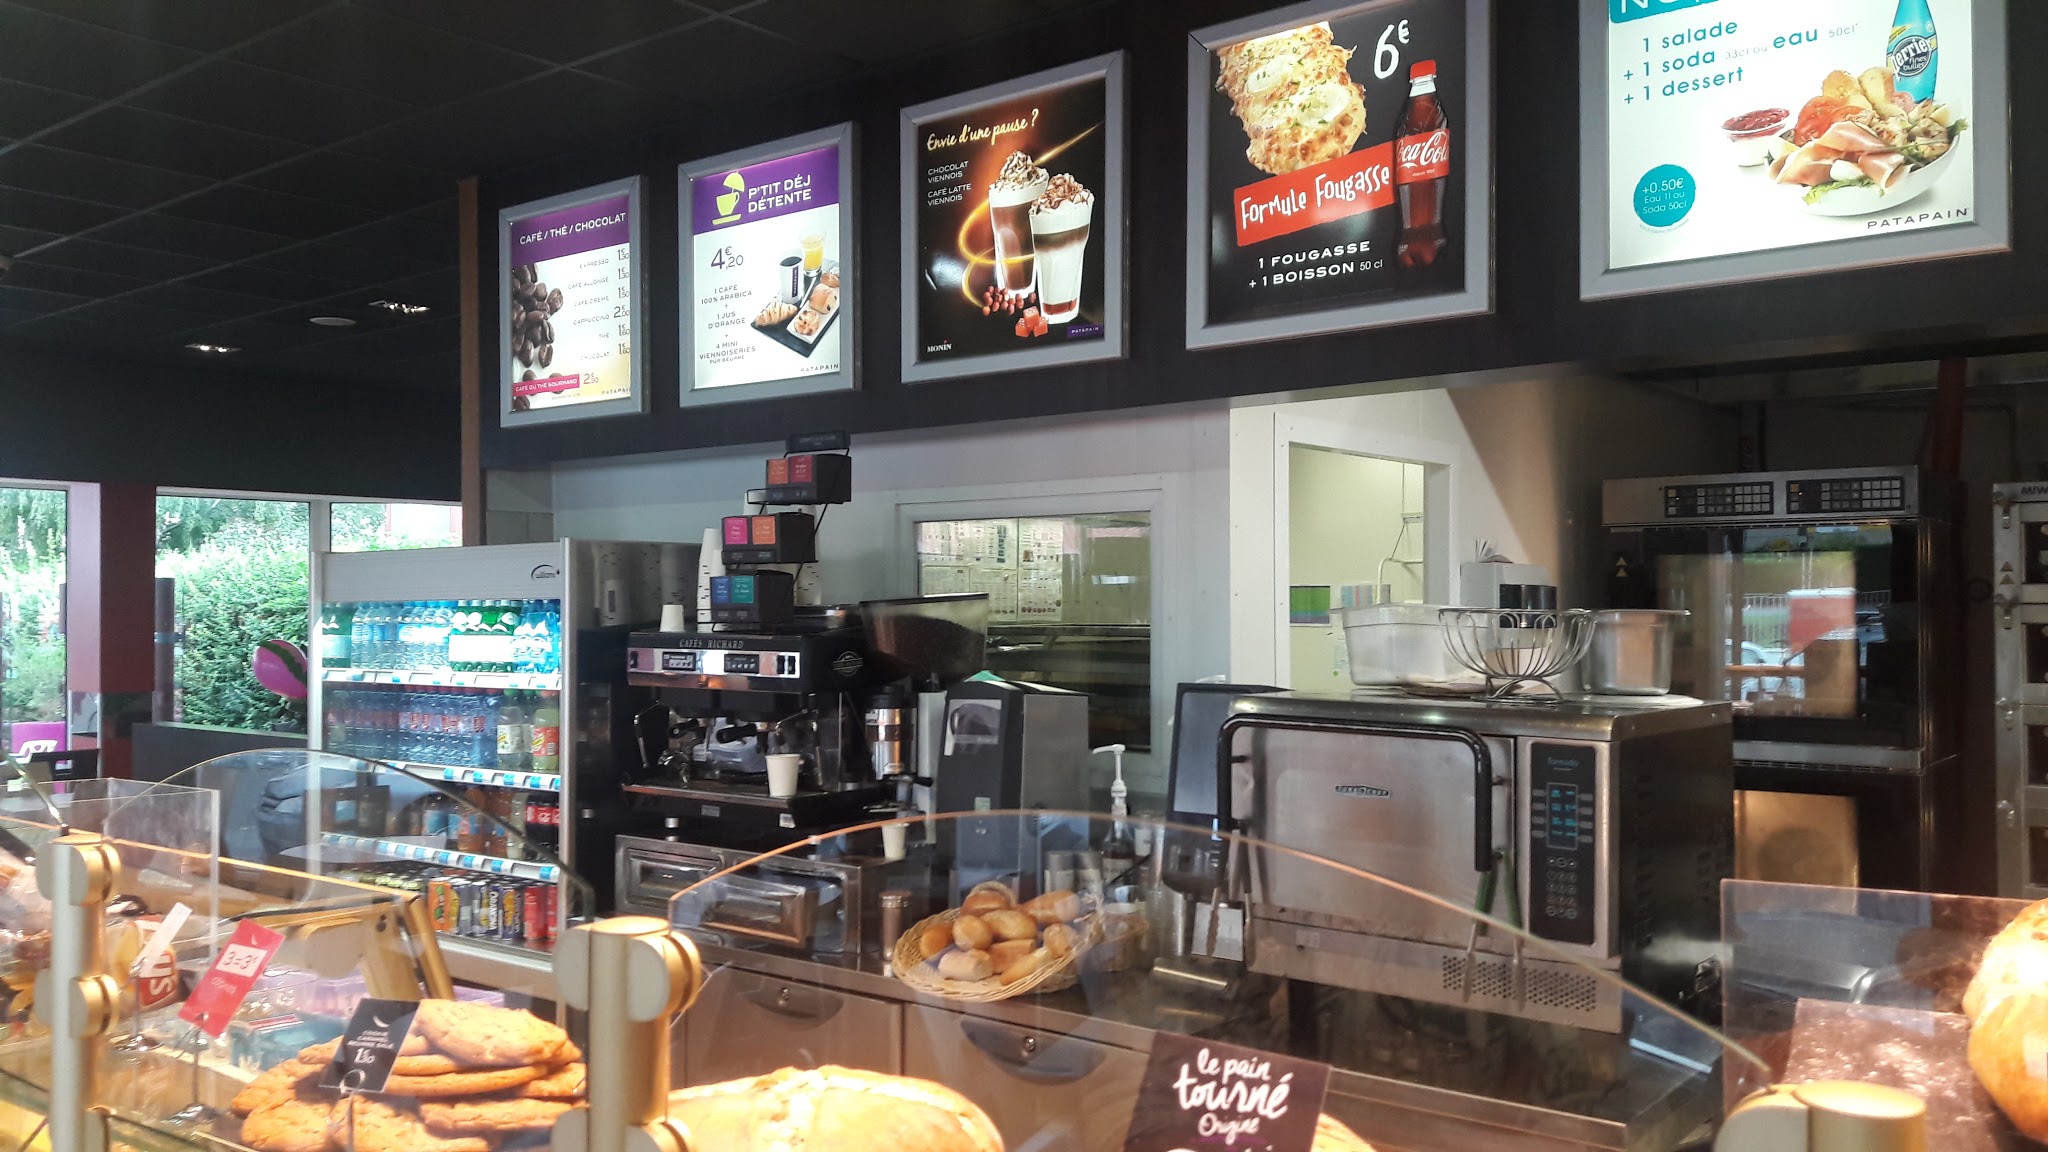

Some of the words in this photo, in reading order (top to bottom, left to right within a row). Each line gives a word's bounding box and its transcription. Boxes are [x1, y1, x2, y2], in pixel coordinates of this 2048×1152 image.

[1642, 37, 1651, 53] 1
[1661, 21, 1739, 50] salade
[1373, 18, 1411, 79] 6€
[1642, 61, 1651, 77] 1
[1661, 49, 1716, 74] soda
[1772, 28, 1819, 50] eau
[1642, 85, 1651, 101] 1
[1661, 65, 1745, 98] dessert
[926, 132, 958, 152] Envie
[958, 123, 992, 144] d'une
[990, 116, 1029, 146] pause
[927, 160, 970, 176] CHOCOLAT
[783, 173, 811, 192] DÉJ
[927, 170, 963, 184] VIENNOIS
[948, 183, 972, 196] LATTE
[1644, 194, 1661, 204] Eau
[1672, 191, 1685, 199] ou
[747, 188, 812, 213] DÉTENTE
[927, 193, 963, 207] VIENNOIS
[1642, 204, 1666, 215] Soda
[1866, 207, 1968, 230] PATAPAIN
[519, 229, 543, 245] CAFÉ
[549, 225, 568, 239] THÉ
[574, 212, 627, 232] CHOCOLAT
[1257, 257, 1265, 269] 1
[1271, 240, 1371, 267] FOUGASSE
[1262, 275, 1269, 287] 1
[1272, 261, 1355, 286] BOISSON
[1359, 260, 1372, 272] 50
[1373, 258, 1384, 270] cl
[701, 296, 719, 305] 100%
[720, 290, 753, 302] ARABICA
[707, 317, 746, 330] D'ORANGE
[721, 311, 736, 320] JUS
[721, 340, 739, 349] MINI
[699, 346, 757, 361] VIENNOISERIES
[800, 363, 840, 373] PATAPAIN
[547, 378, 578, 389] GOURMAND
[706, 639, 745, 650] RICHARD
[1196, 1047, 1222, 1076] le
[1222, 1056, 1272, 1085] pain
[1172, 1061, 1295, 1120] tourné
